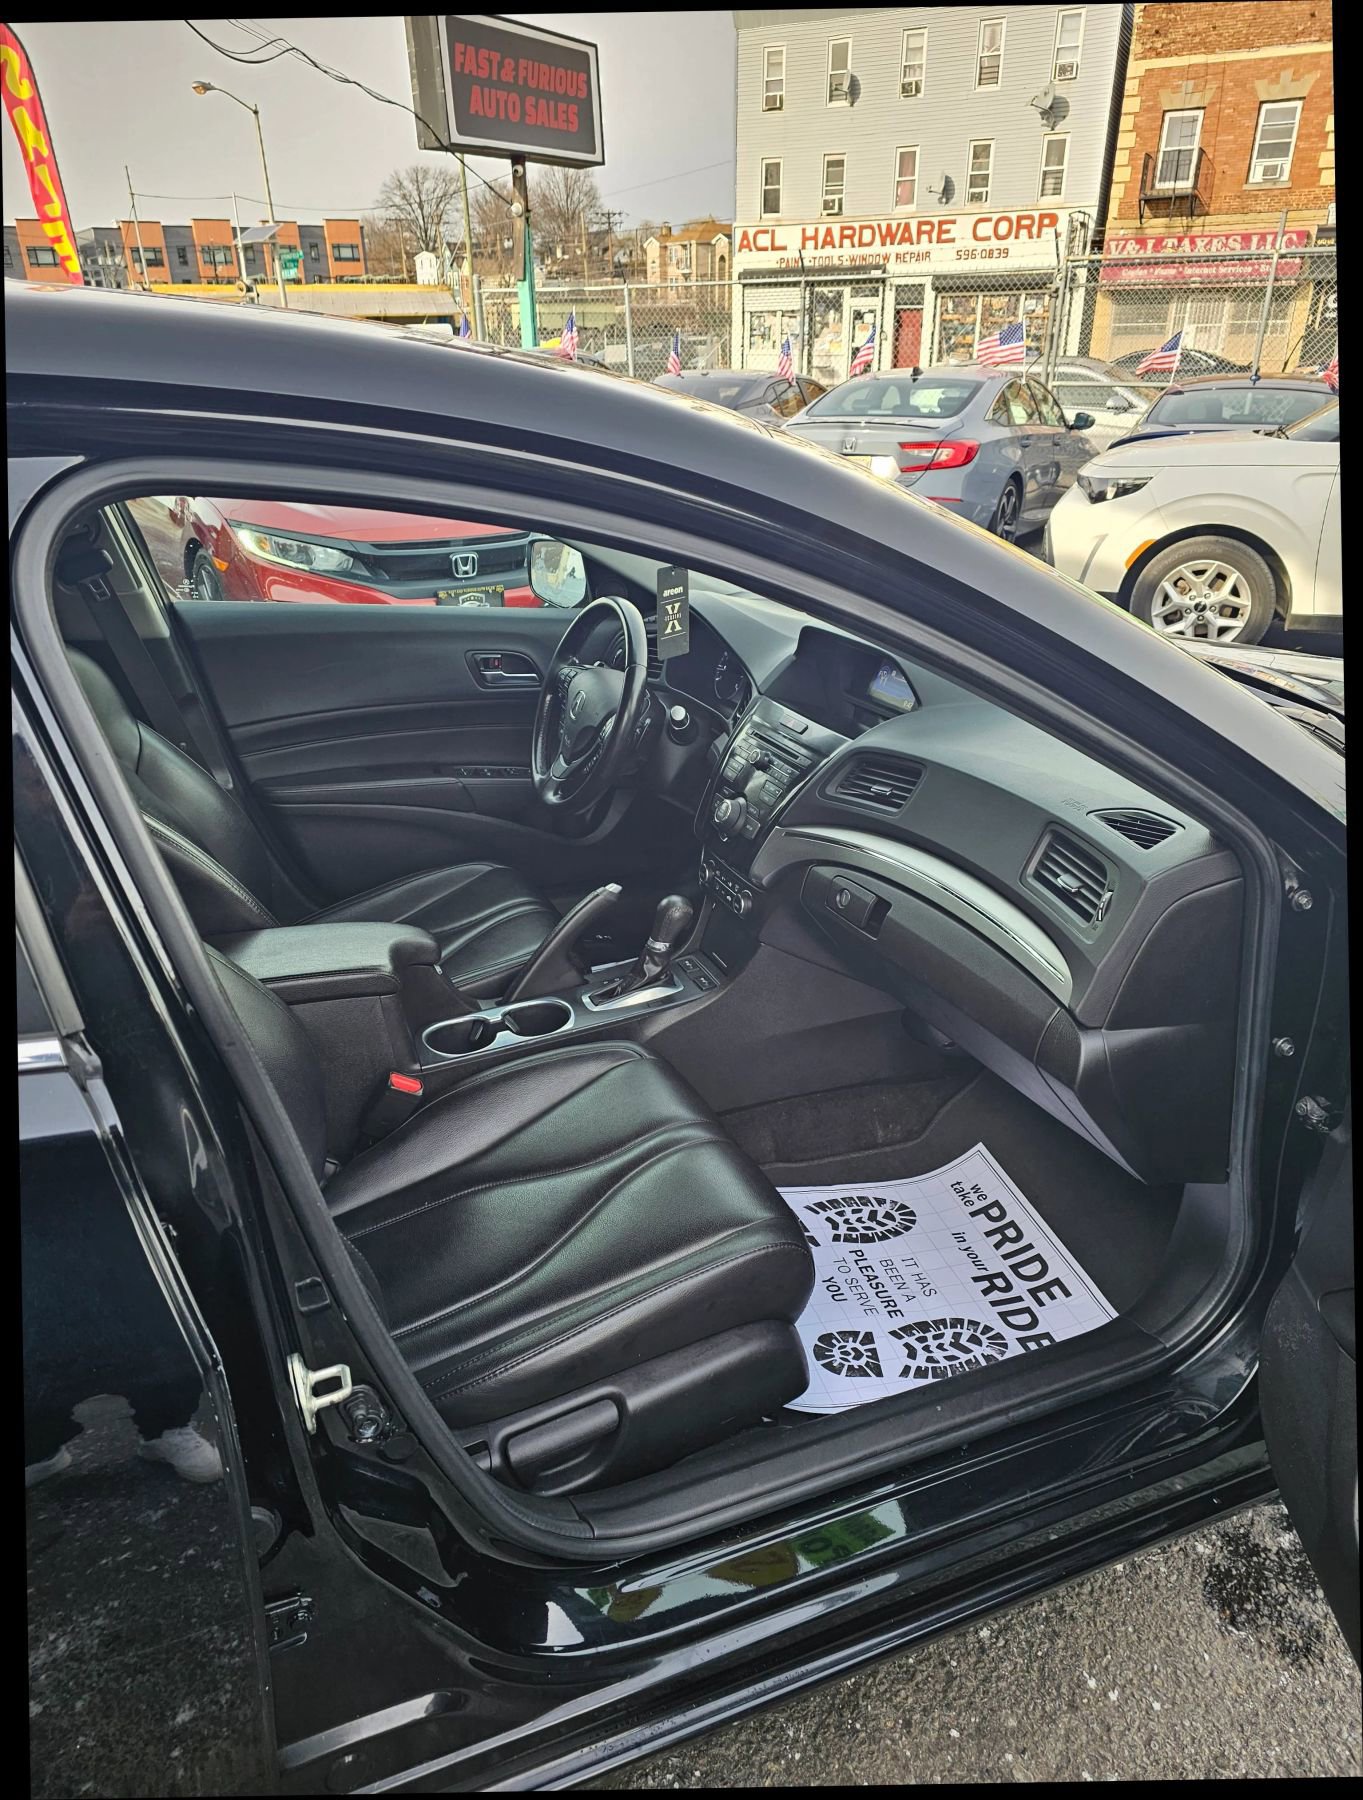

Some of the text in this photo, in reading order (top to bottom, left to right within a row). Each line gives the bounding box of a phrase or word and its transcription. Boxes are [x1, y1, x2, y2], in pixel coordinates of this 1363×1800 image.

[454, 42, 588, 99] FAST & FURIOUS
[469, 84, 579, 133] AUTO SALES
[738, 229, 788, 252] ACL
[801, 219, 957, 251] HARDWARE
[1161, 235, 1242, 255] TAXES
[848, 252, 892, 266] WINDOW
[895, 251, 931, 264] REPAIR
[662, 586, 684, 597] areon
[950, 1180, 1073, 1308] we take PRIDE
[951, 1231, 967, 1244] in
[958, 1245, 989, 1272] your
[821, 1276, 848, 1302] YOU
[833, 1257, 880, 1316] TO SERVE
[848, 1249, 905, 1319] PLEASURE
[879, 1258, 916, 1302] BEEN A
[901, 1257, 937, 1297] IT HAS
